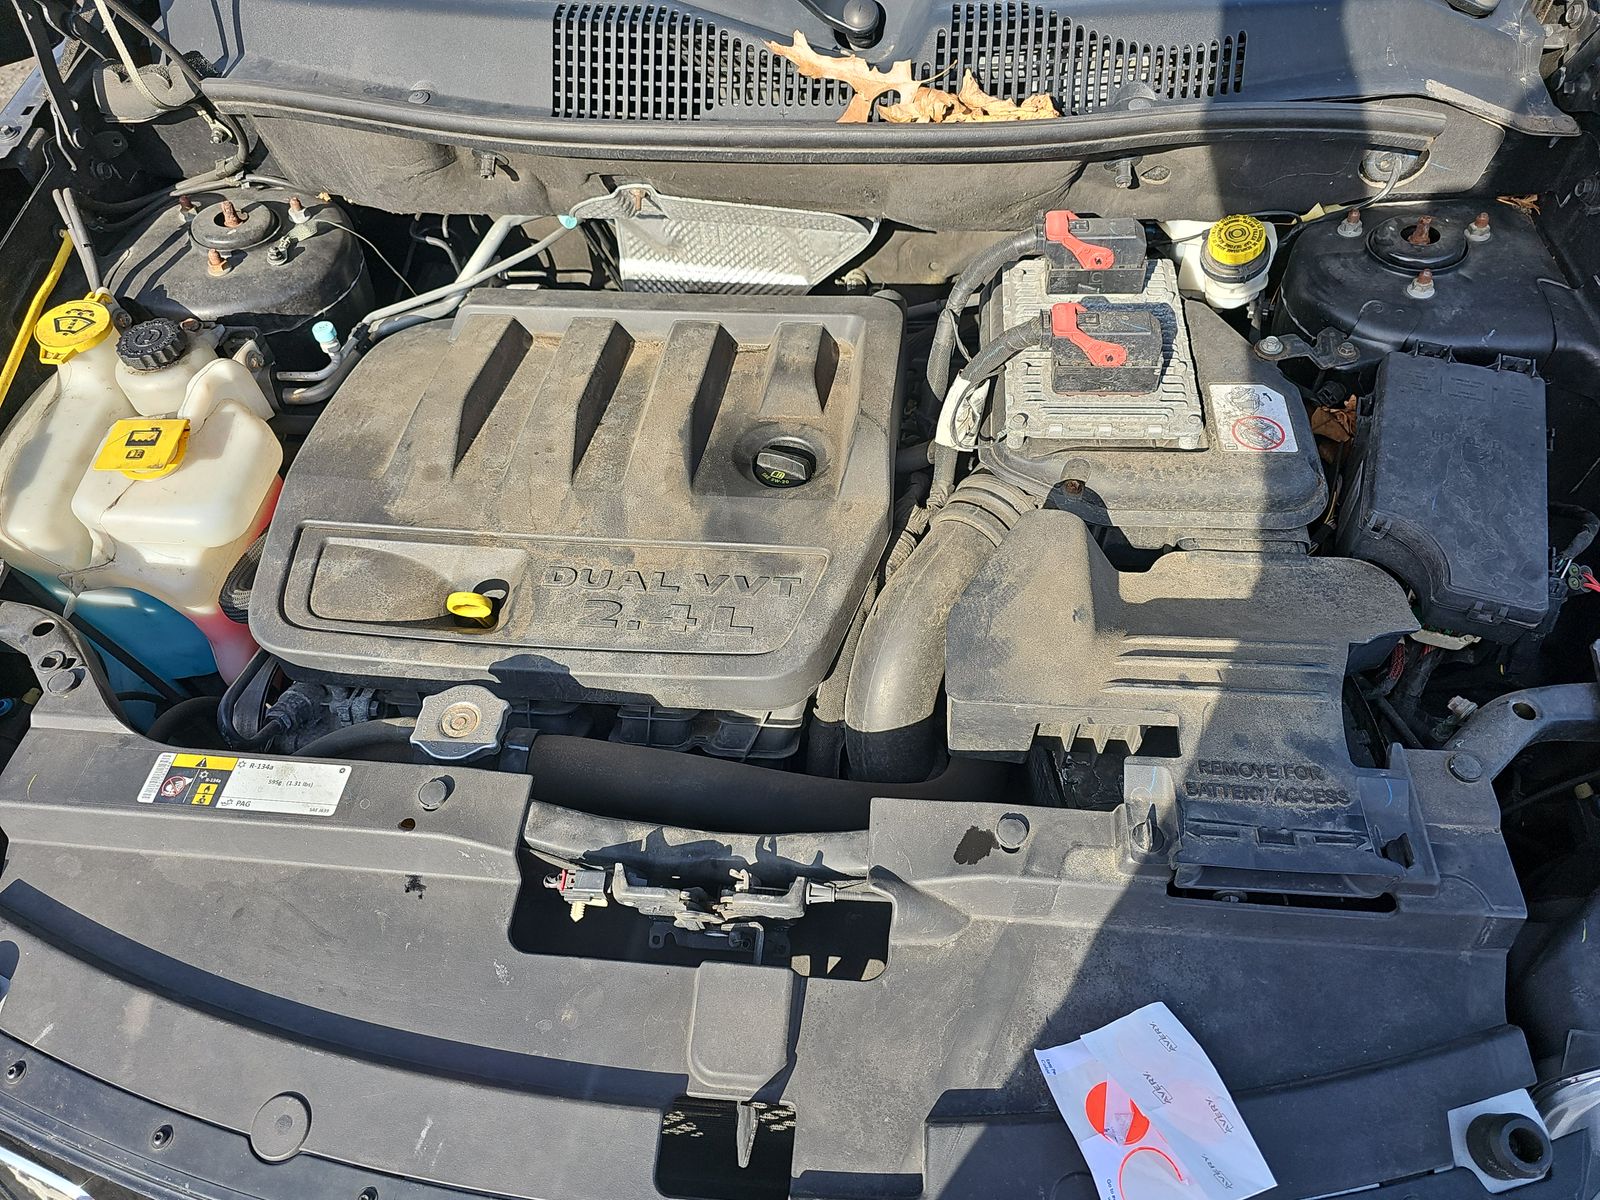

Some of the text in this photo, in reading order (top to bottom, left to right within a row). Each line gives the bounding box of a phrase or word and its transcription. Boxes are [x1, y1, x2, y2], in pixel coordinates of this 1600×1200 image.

[541, 566, 802, 597] DUAL VVT
[577, 599, 754, 636] 2.4L
[249, 762, 274, 771] R-134a
[1198, 760, 1326, 781] REMOVE FOR
[268, 779, 282, 787] 595g
[1185, 781, 1351, 805] BATTERY ACCESS
[235, 800, 251, 808] PAG
